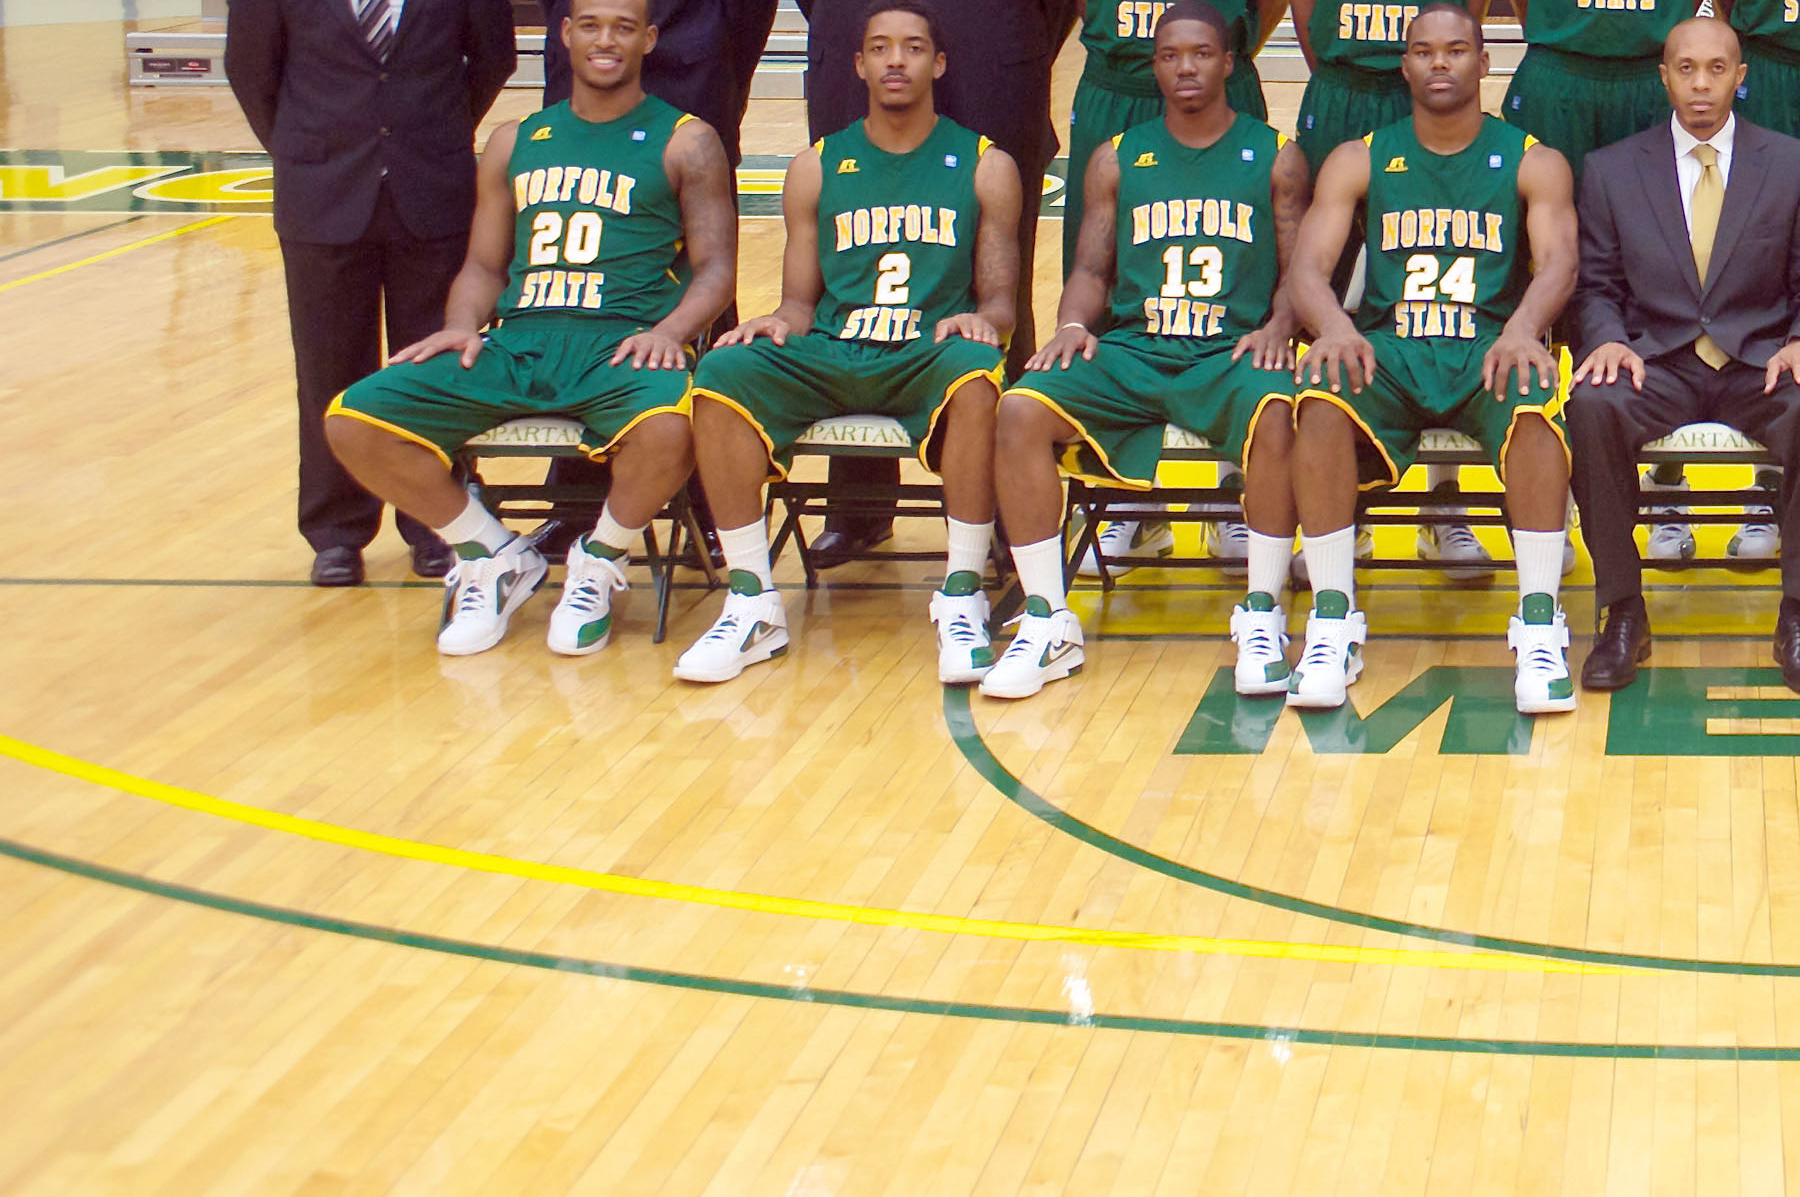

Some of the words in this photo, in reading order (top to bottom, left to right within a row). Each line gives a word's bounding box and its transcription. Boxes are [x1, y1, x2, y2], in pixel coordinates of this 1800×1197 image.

[1339, 3, 1419, 42] STATE
[514, 166, 635, 214] NORFOLK
[529, 211, 602, 265] 20
[834, 205, 957, 252] NORFOLK
[1132, 198, 1254, 245] NORFOLK
[1381, 209, 1503, 253] NORFOLK
[518, 271, 604, 309] STATE
[874, 252, 911, 305] 2
[1160, 245, 1223, 298] 13
[1402, 254, 1476, 303] 24
[839, 307, 922, 343] STATE
[1143, 297, 1226, 337] STATE
[1395, 302, 1477, 339] STATE
[802, 424, 910, 444] PARTAN
